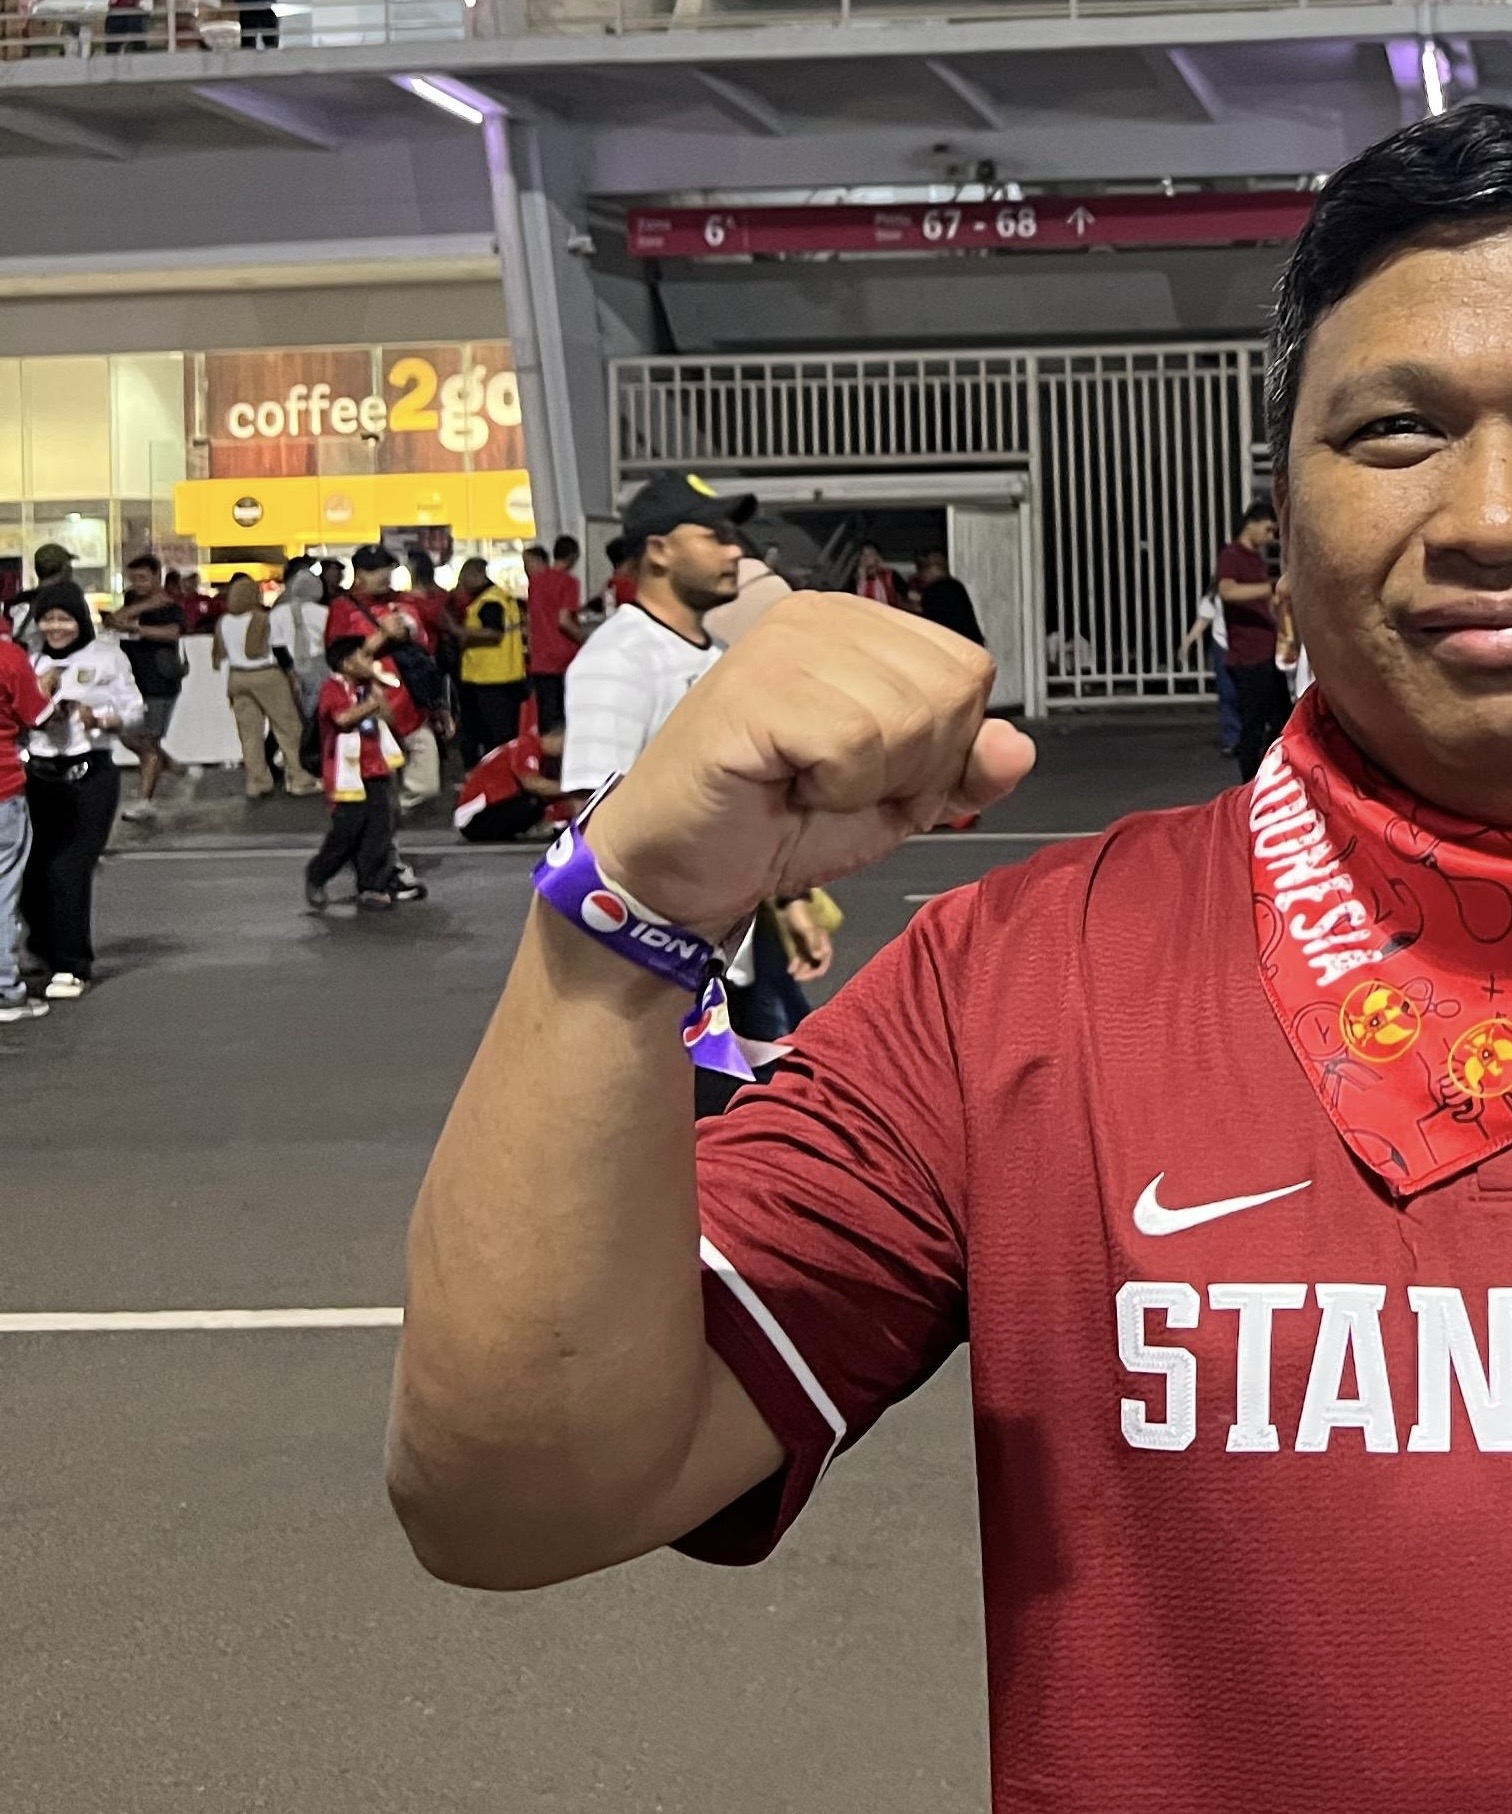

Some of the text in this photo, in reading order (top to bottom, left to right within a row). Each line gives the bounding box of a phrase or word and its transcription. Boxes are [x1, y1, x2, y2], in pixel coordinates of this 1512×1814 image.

[922, 208, 962, 241] 67
[995, 205, 1038, 239] 68
[629, 922, 699, 960] IDN
